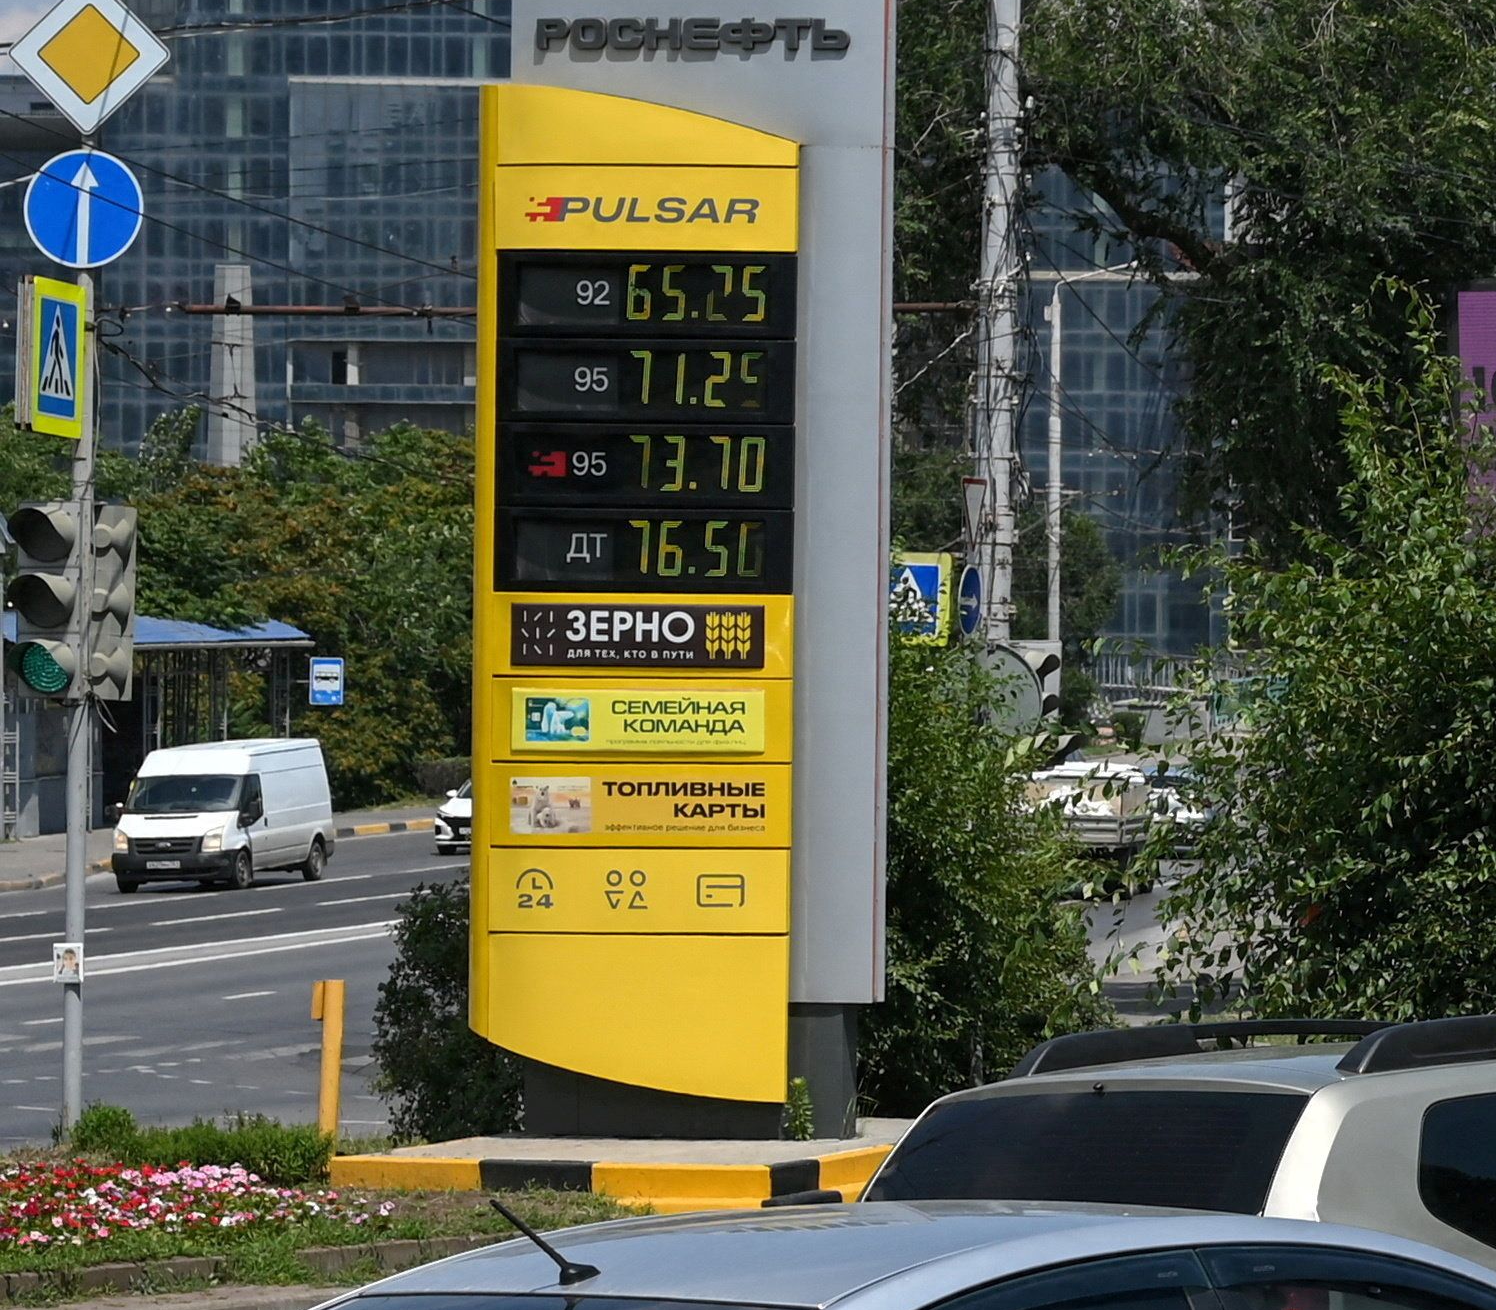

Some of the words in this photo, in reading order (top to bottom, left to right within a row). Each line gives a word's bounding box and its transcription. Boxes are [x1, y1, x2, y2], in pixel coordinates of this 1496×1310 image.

[535, 17, 851, 52] РОСНЕФТЬ
[557, 195, 760, 225] PULSAR
[575, 279, 611, 307] 92
[626, 263, 767, 322] 65.25
[573, 366, 610, 392] 95
[571, 450, 607, 477] 95
[628, 434, 767, 493] 73.70
[566, 532, 608, 564] ДТ
[628, 519, 763, 578] 76.50
[565, 609, 696, 644] ЗЕРНО
[567, 648, 591, 660] ДЛЯ
[594, 648, 620, 661] ТЕХ,
[624, 648, 647, 660] КТО
[651, 649, 659, 659] В
[663, 649, 694, 660] ПУТИ
[611, 696, 746, 716] СЕМЕЙНАЯ
[623, 718, 746, 736] КОМАНДА
[602, 781, 766, 798] ТОПЛИВНЫЕ
[673, 803, 766, 819] КАРТЫ
[707, 824, 726, 833] для
[517, 892, 554, 909] 24
